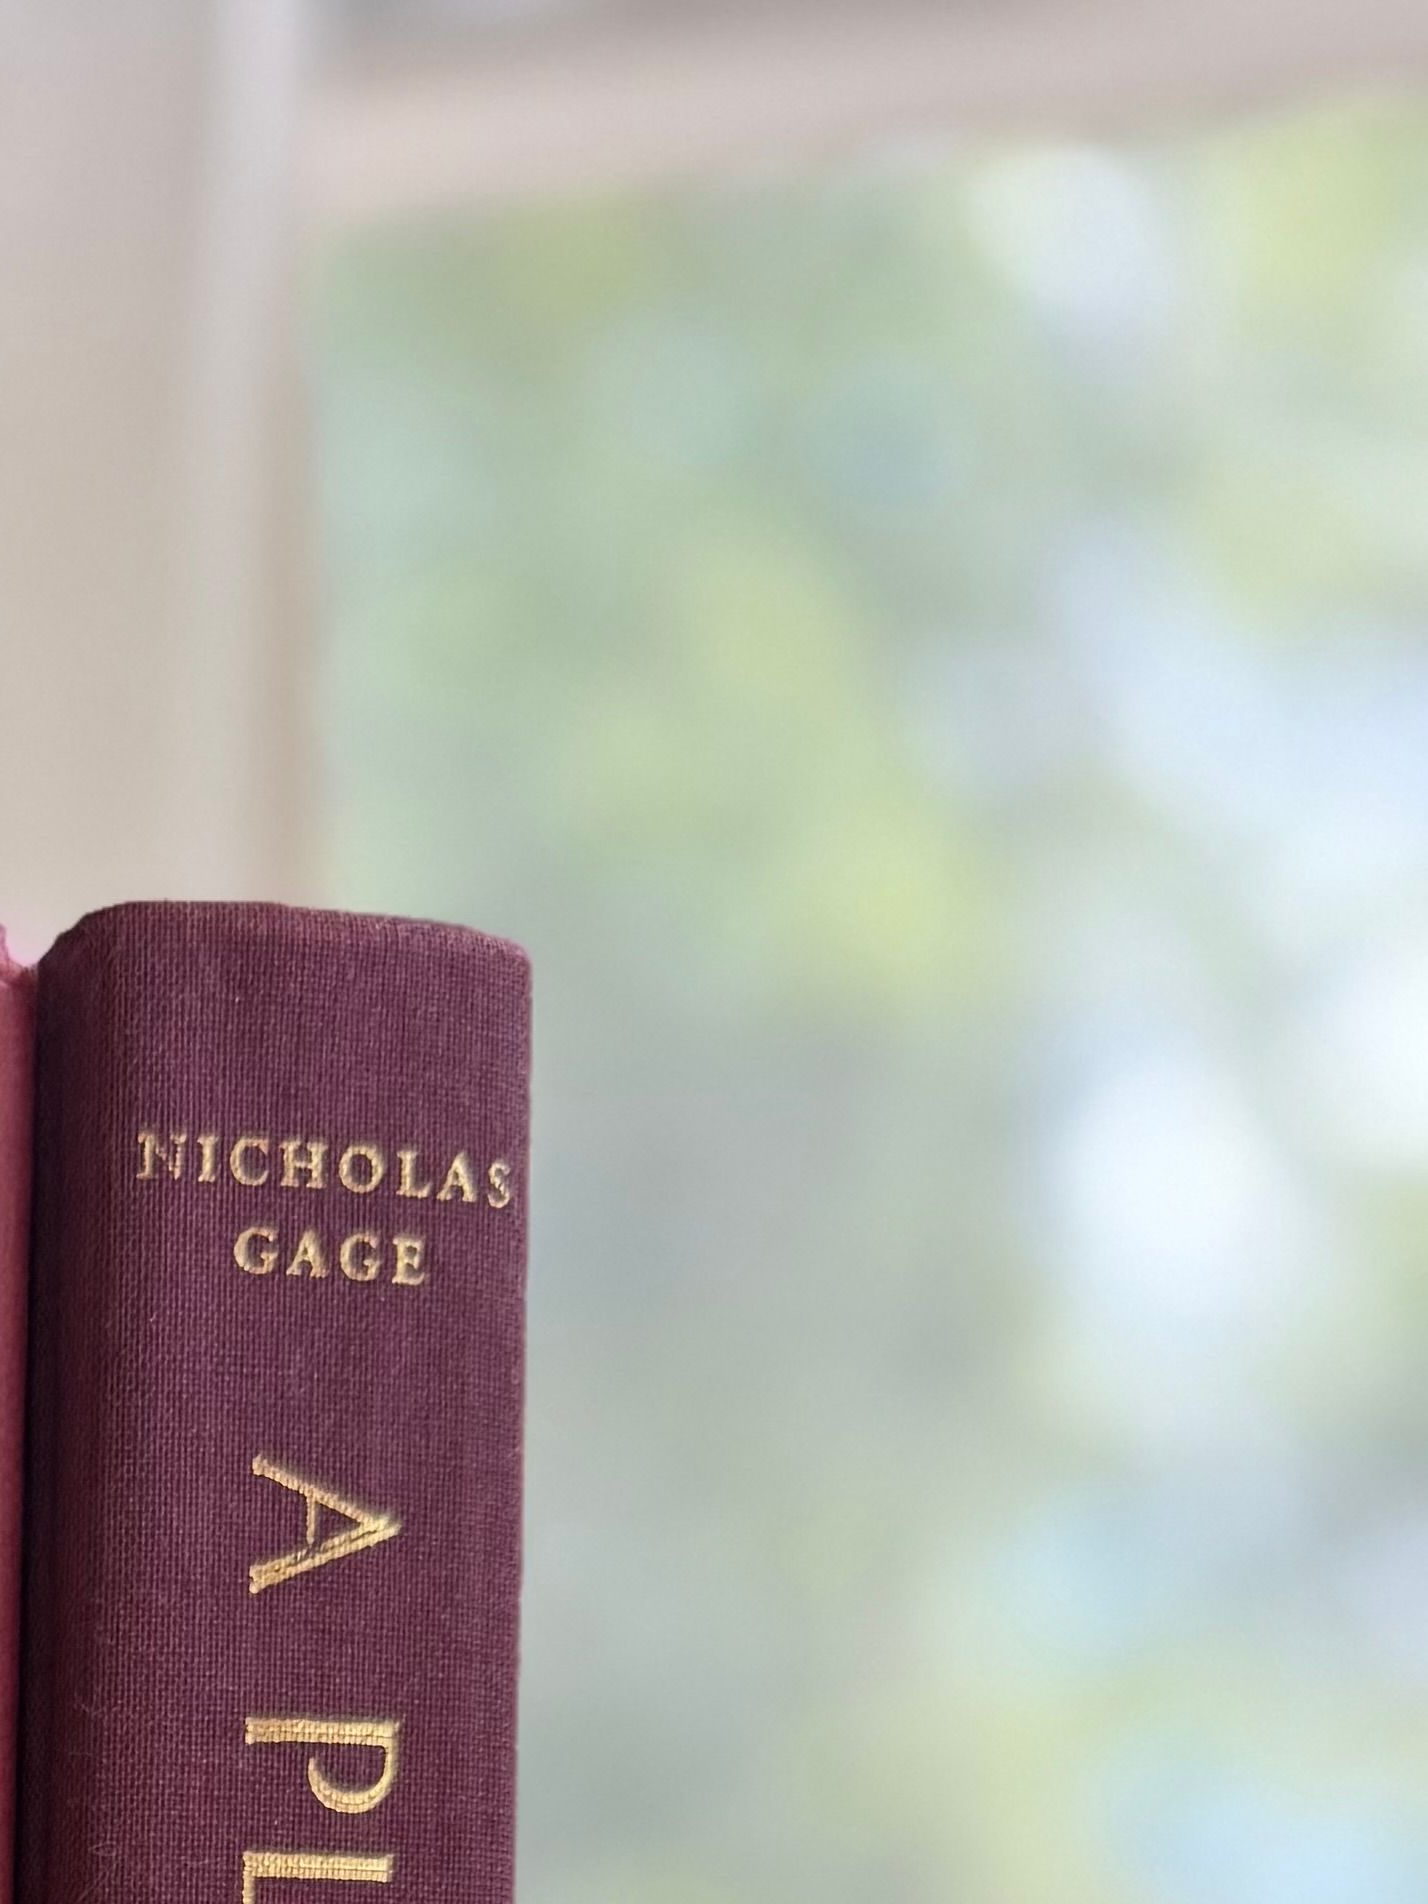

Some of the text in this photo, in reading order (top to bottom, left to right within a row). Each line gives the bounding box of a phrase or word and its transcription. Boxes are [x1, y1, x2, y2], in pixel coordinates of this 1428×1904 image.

[134, 1129, 515, 1211] NICHOLAS
[233, 1224, 429, 1288] GAGE
[250, 1452, 404, 1597] A
